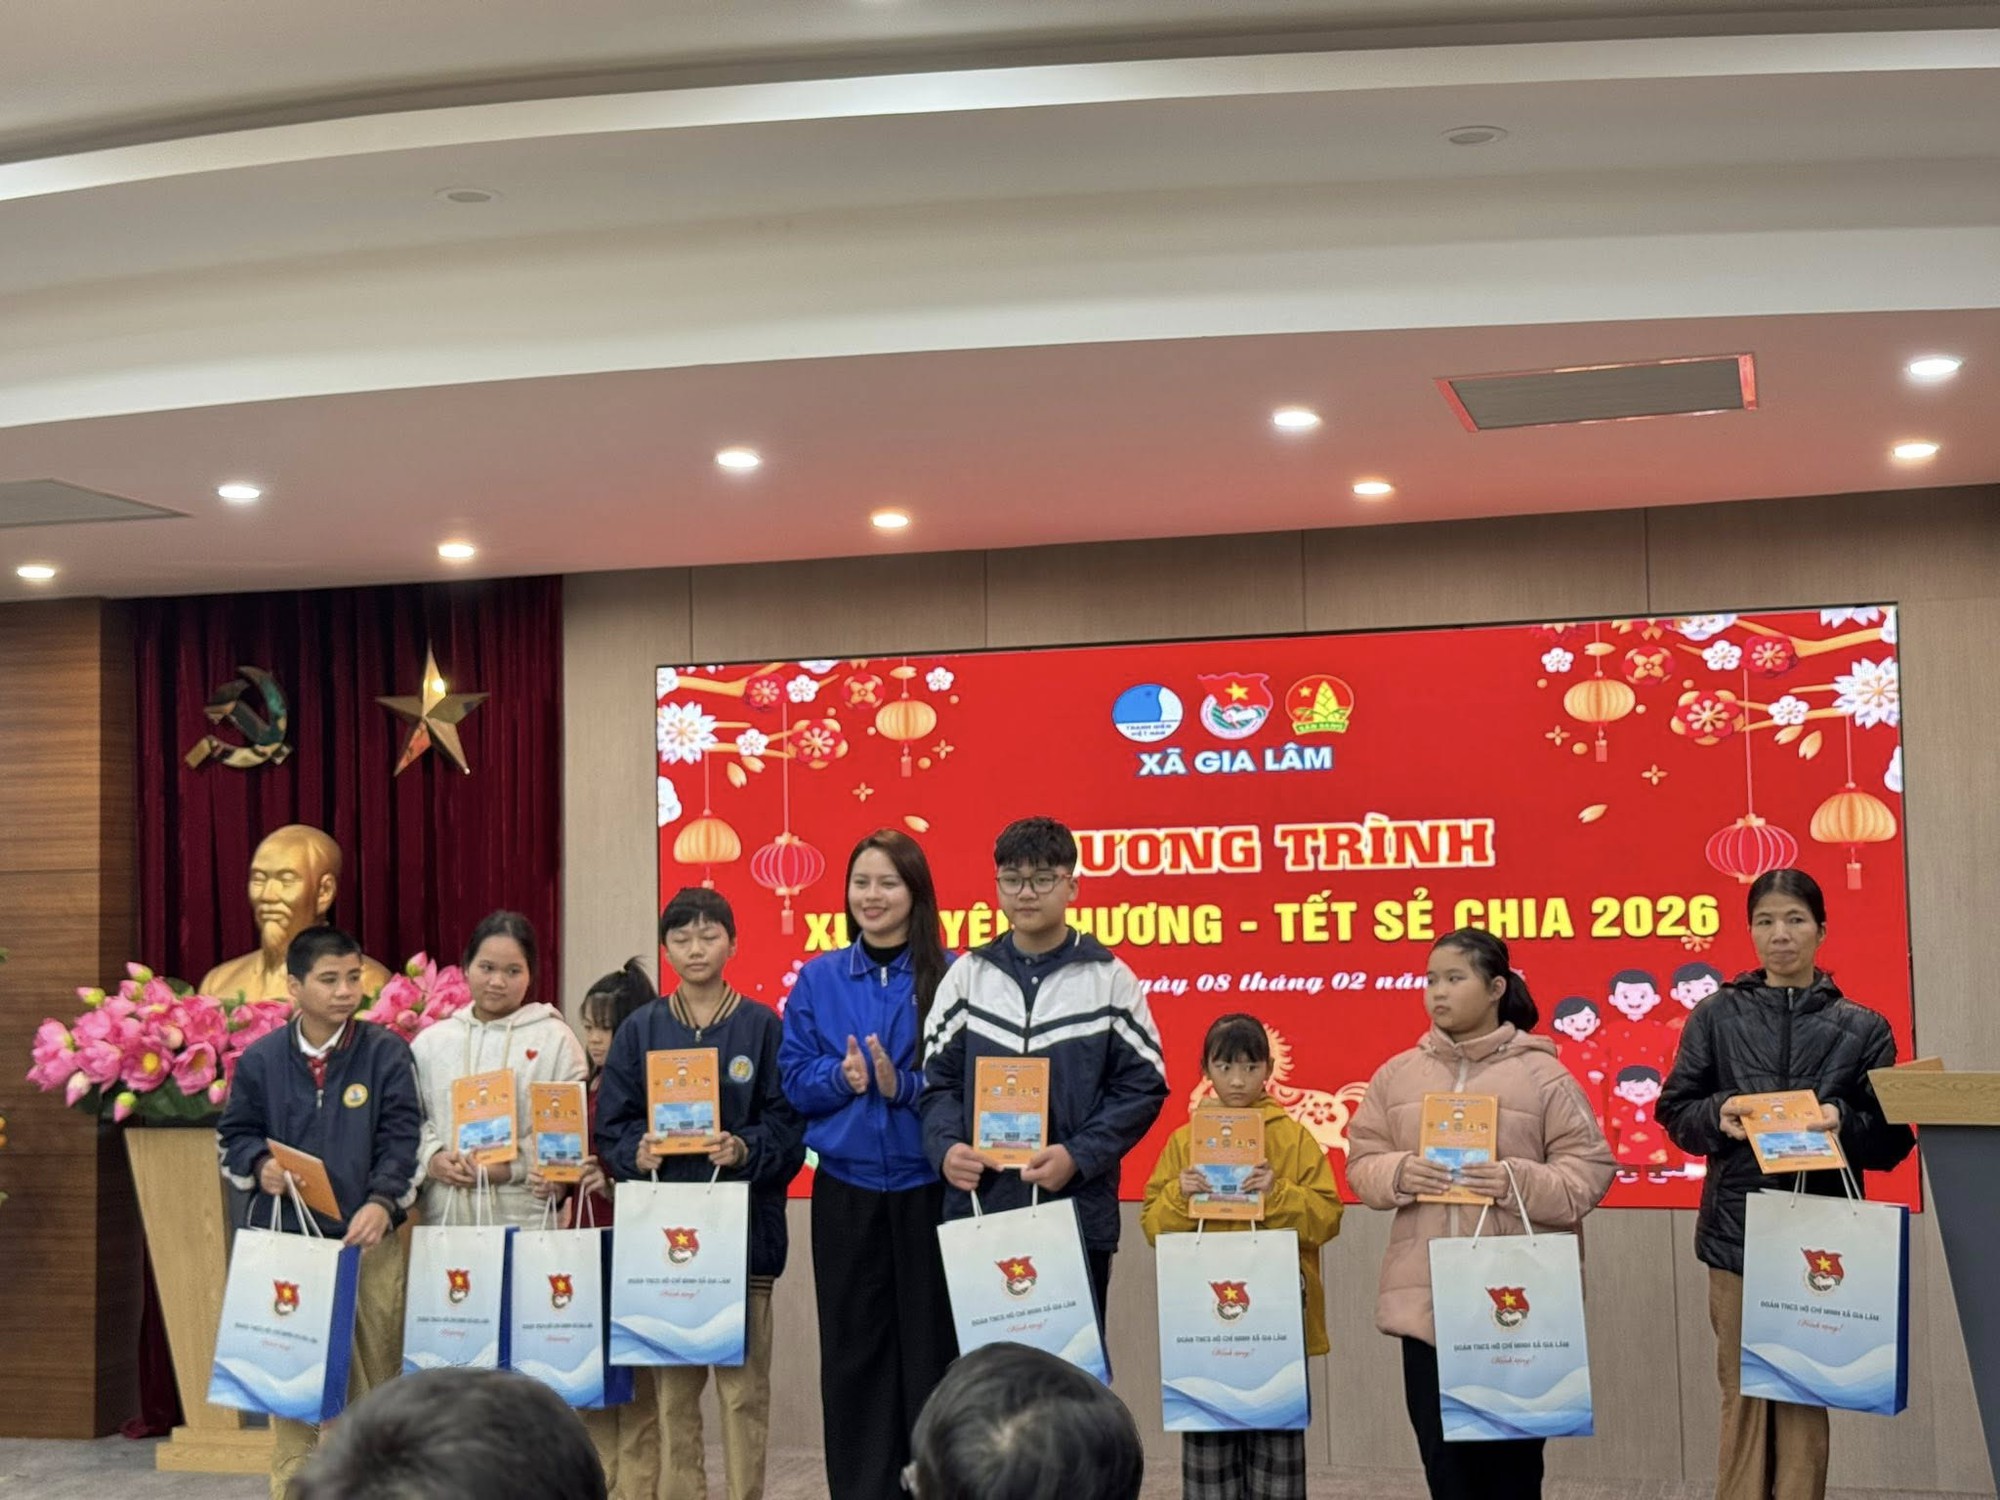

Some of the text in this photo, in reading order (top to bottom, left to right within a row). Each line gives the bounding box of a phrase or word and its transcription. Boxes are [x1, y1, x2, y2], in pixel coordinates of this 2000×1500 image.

[1138, 741, 1334, 776] XÃ GIA LÂM
[1073, 811, 1495, 877] ƯƠNG TRÌNH
[1065, 903, 1223, 946] HƯƠNG
[1239, 920, 1259, 933] -
[1274, 889, 1358, 942] TẾT
[1374, 888, 1435, 941] SẺ
[1454, 897, 1575, 939] CHIA
[1591, 895, 1720, 939] 2026
[1196, 973, 1233, 993] 08
[1239, 971, 1326, 993] tháng
[1331, 972, 1366, 991] 02
